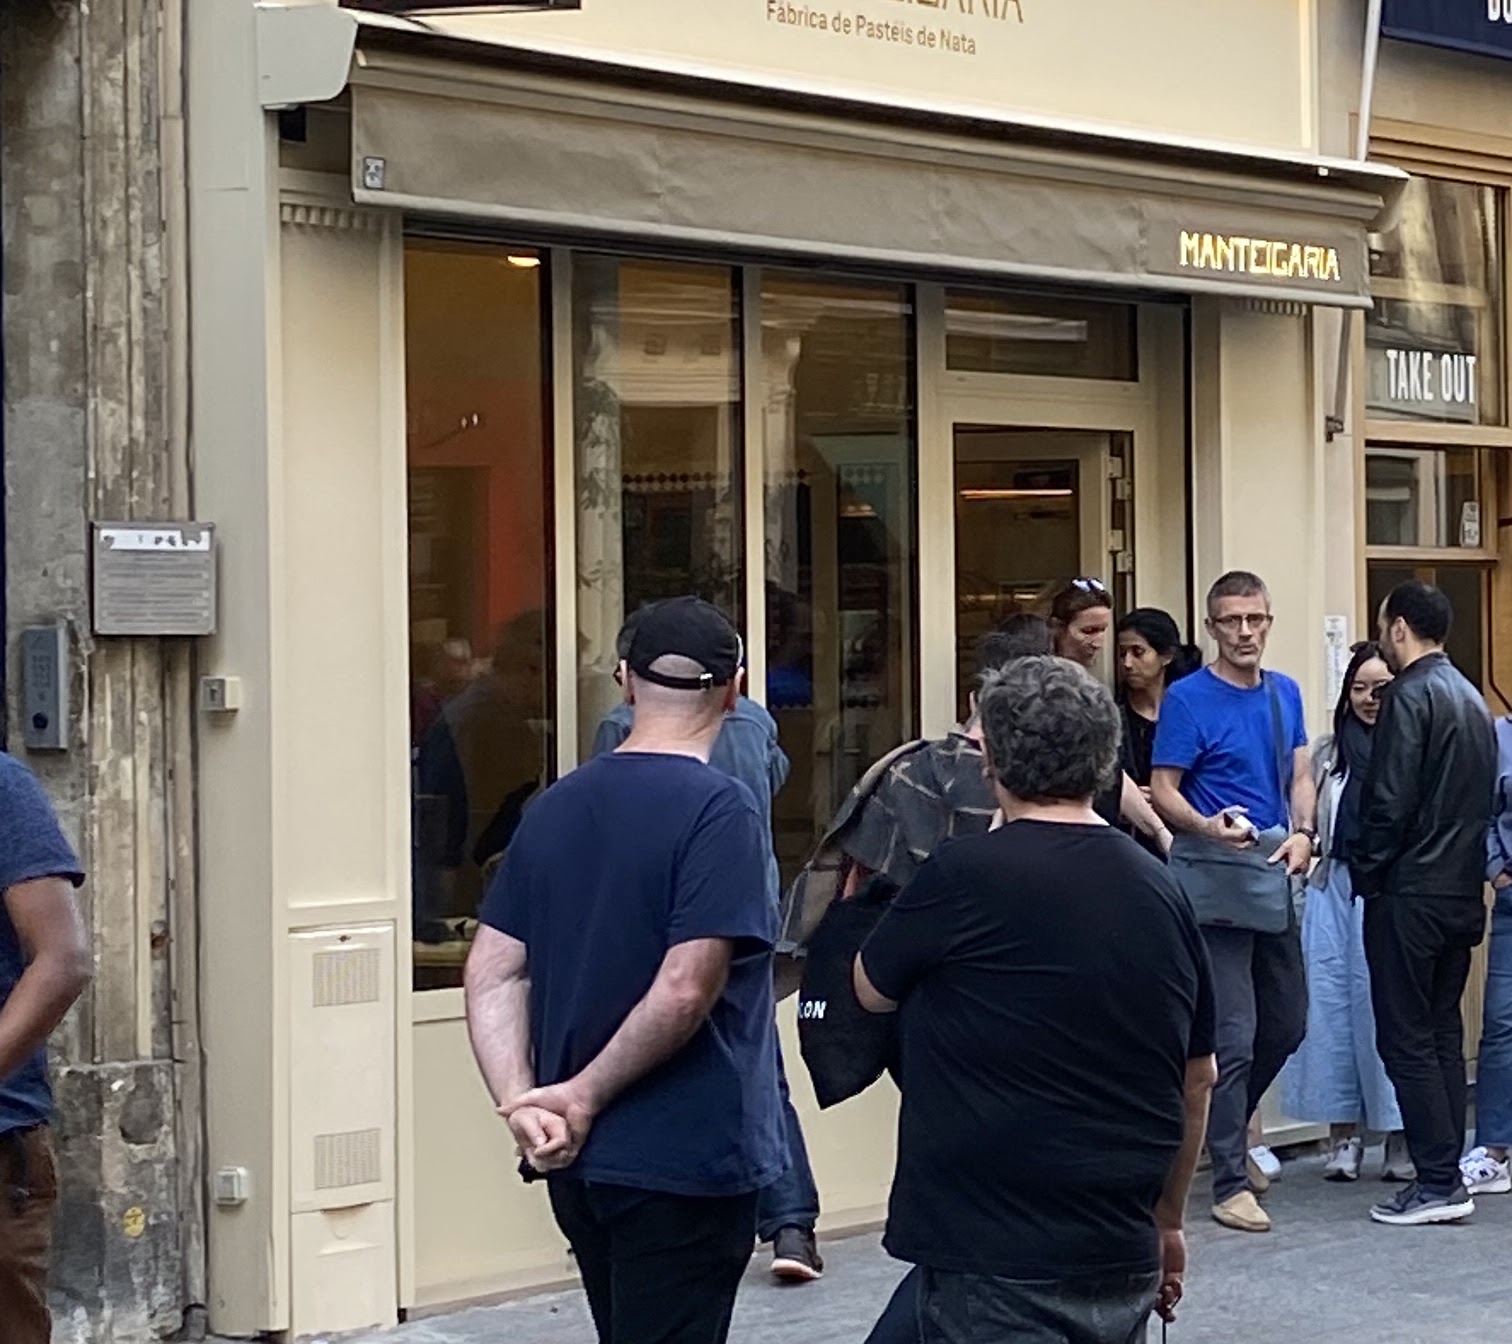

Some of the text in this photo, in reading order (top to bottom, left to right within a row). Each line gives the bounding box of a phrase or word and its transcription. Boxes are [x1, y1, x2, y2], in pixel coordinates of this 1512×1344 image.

[766, 0, 976, 55] Fábrica de Pastéis de Nata
[1179, 230, 1341, 281] MANTEIGARIA
[1386, 349, 1477, 404] TAKE OUT
